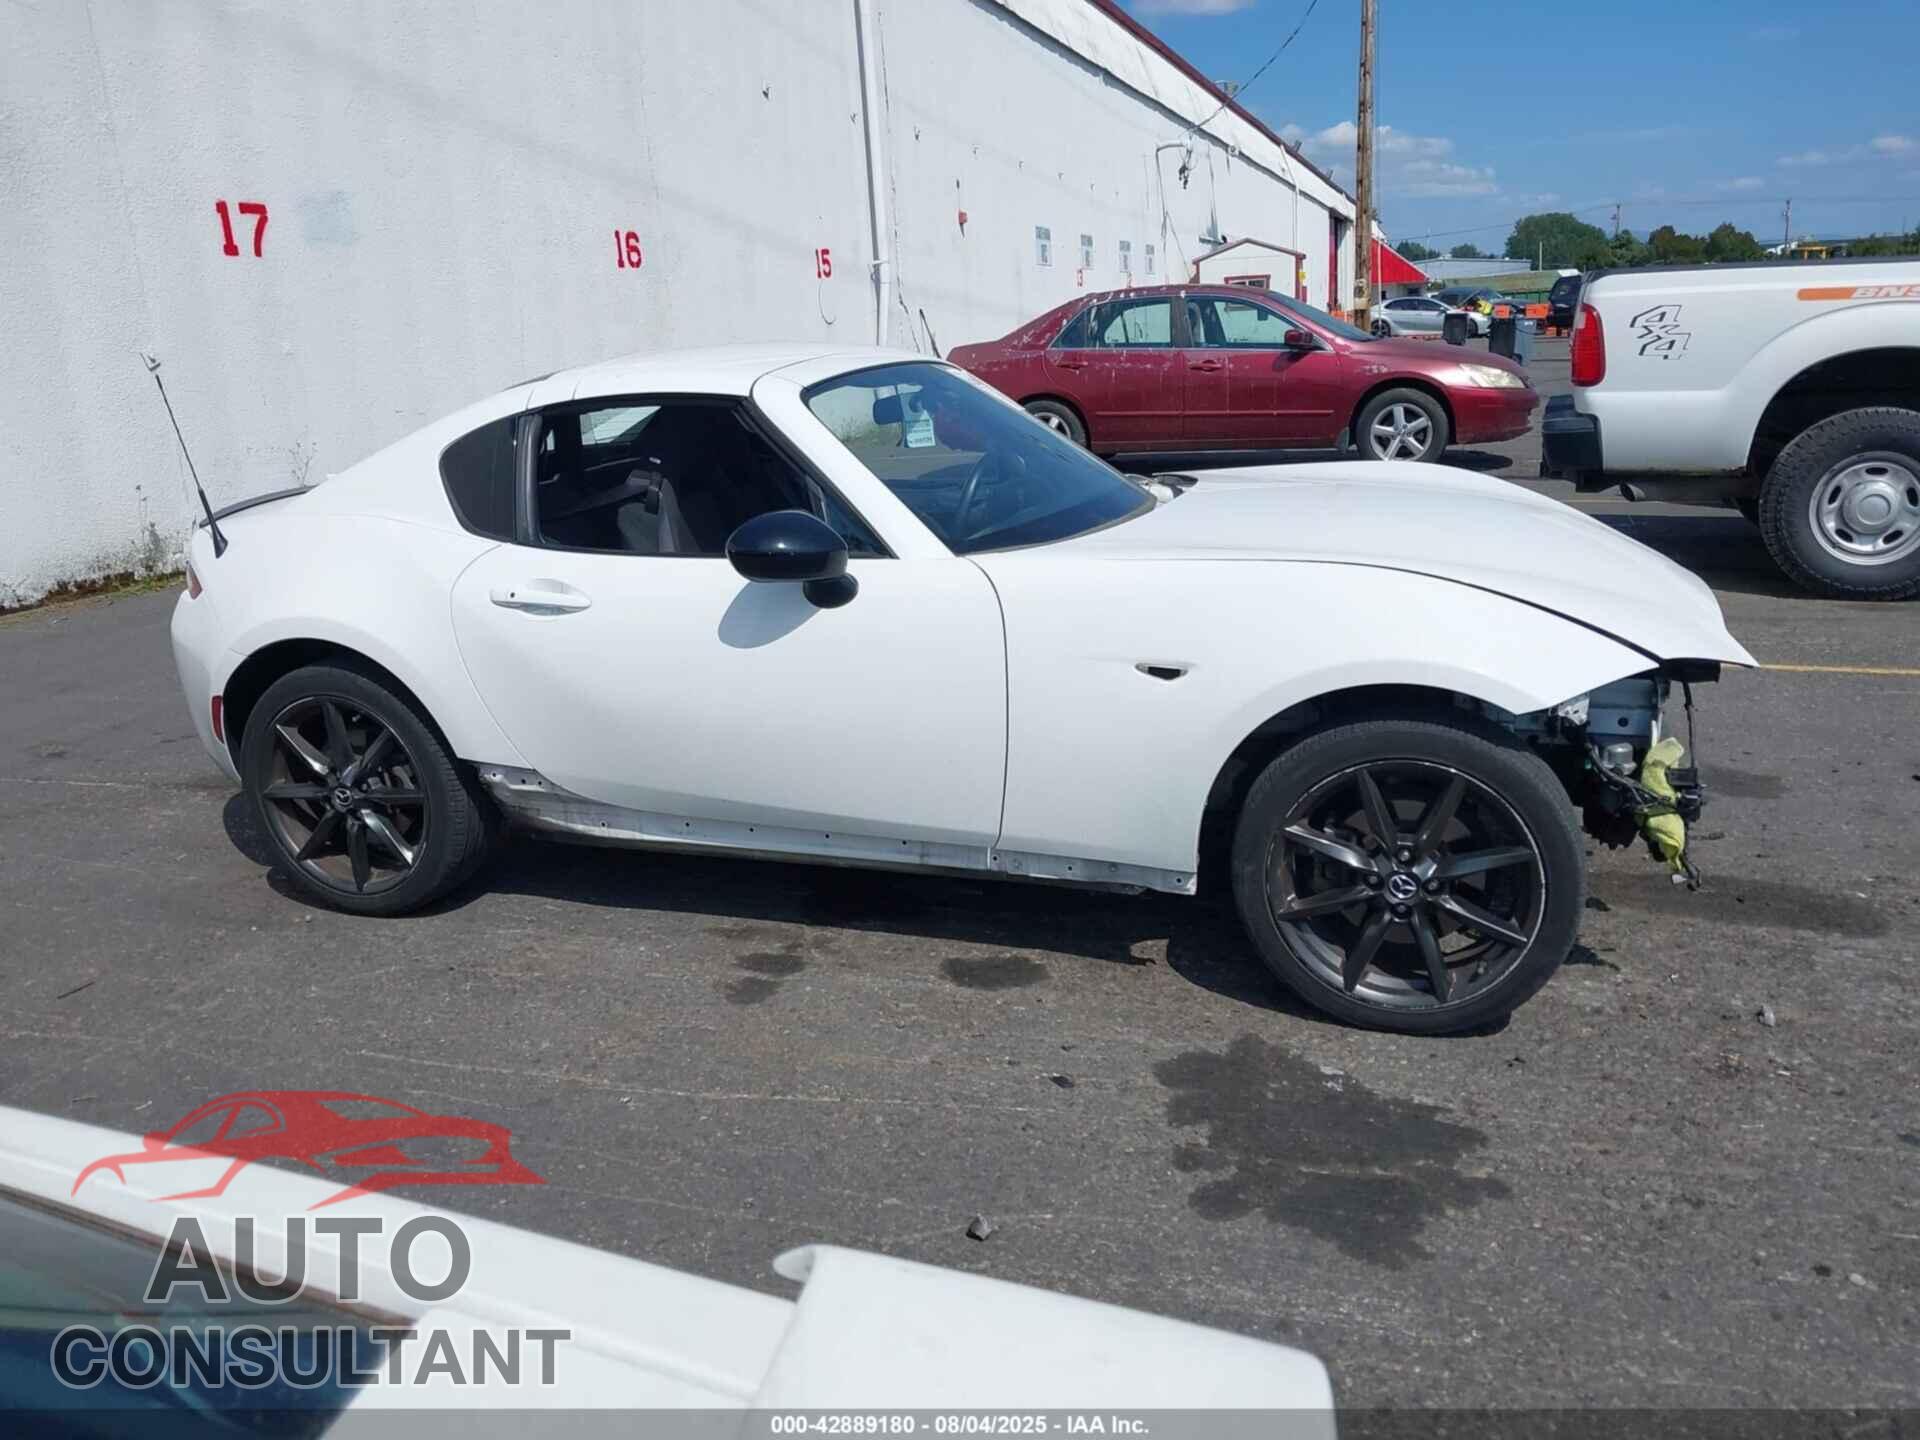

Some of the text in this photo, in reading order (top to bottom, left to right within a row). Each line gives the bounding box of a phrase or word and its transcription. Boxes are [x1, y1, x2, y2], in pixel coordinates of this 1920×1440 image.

[215, 200, 268, 257] 17
[614, 229, 642, 268] 16
[815, 248, 832, 279] 15
